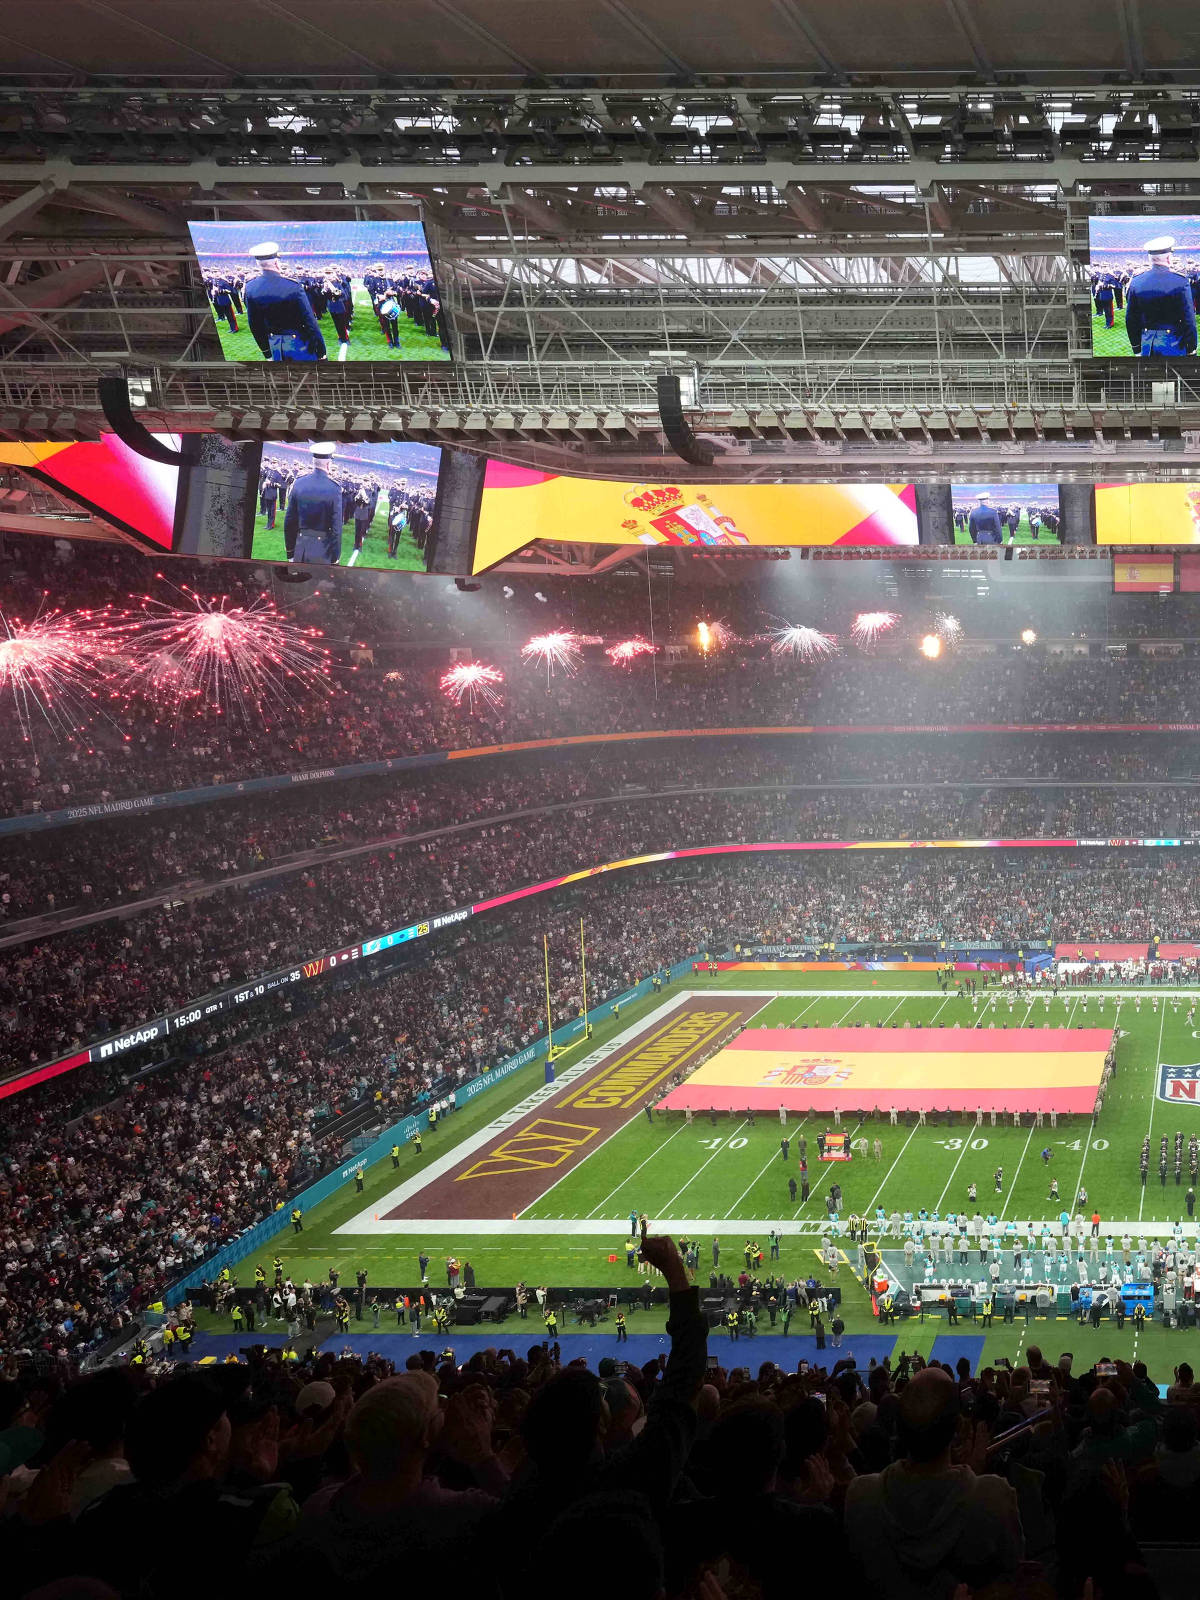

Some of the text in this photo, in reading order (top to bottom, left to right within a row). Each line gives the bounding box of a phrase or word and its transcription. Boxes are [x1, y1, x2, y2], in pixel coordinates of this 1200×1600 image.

[291, 769, 335, 782] MIAMI DOLPHINS
[67, 797, 154, 819] 2025 NFL MADRID GAME
[114, 1027, 159, 1052] NetApp
[174, 1010, 202, 1029] 15:00
[205, 1004, 218, 1014] QTR
[234, 991, 250, 1004] 1ST
[254, 985, 265, 996] 10
[267, 980, 280, 990] BALL
[280, 976, 288, 984] ON
[290, 971, 301, 982] 35
[330, 956, 337, 967] 0
[387, 936, 394, 945] 0
[418, 923, 428, 935] 25
[442, 911, 468, 926] NetApp
[572, 1011, 729, 1109] COMMANDERS
[467, 1049, 536, 1096] 2025 NFL MADRID GAME
[489, 1042, 622, 1130] IT TAKES ALL OF US
[704, 1138, 749, 1150] 10
[943, 1138, 989, 1151] 30
[1065, 1138, 1110, 1151] 40
[348, 1158, 368, 1174] NetApp
